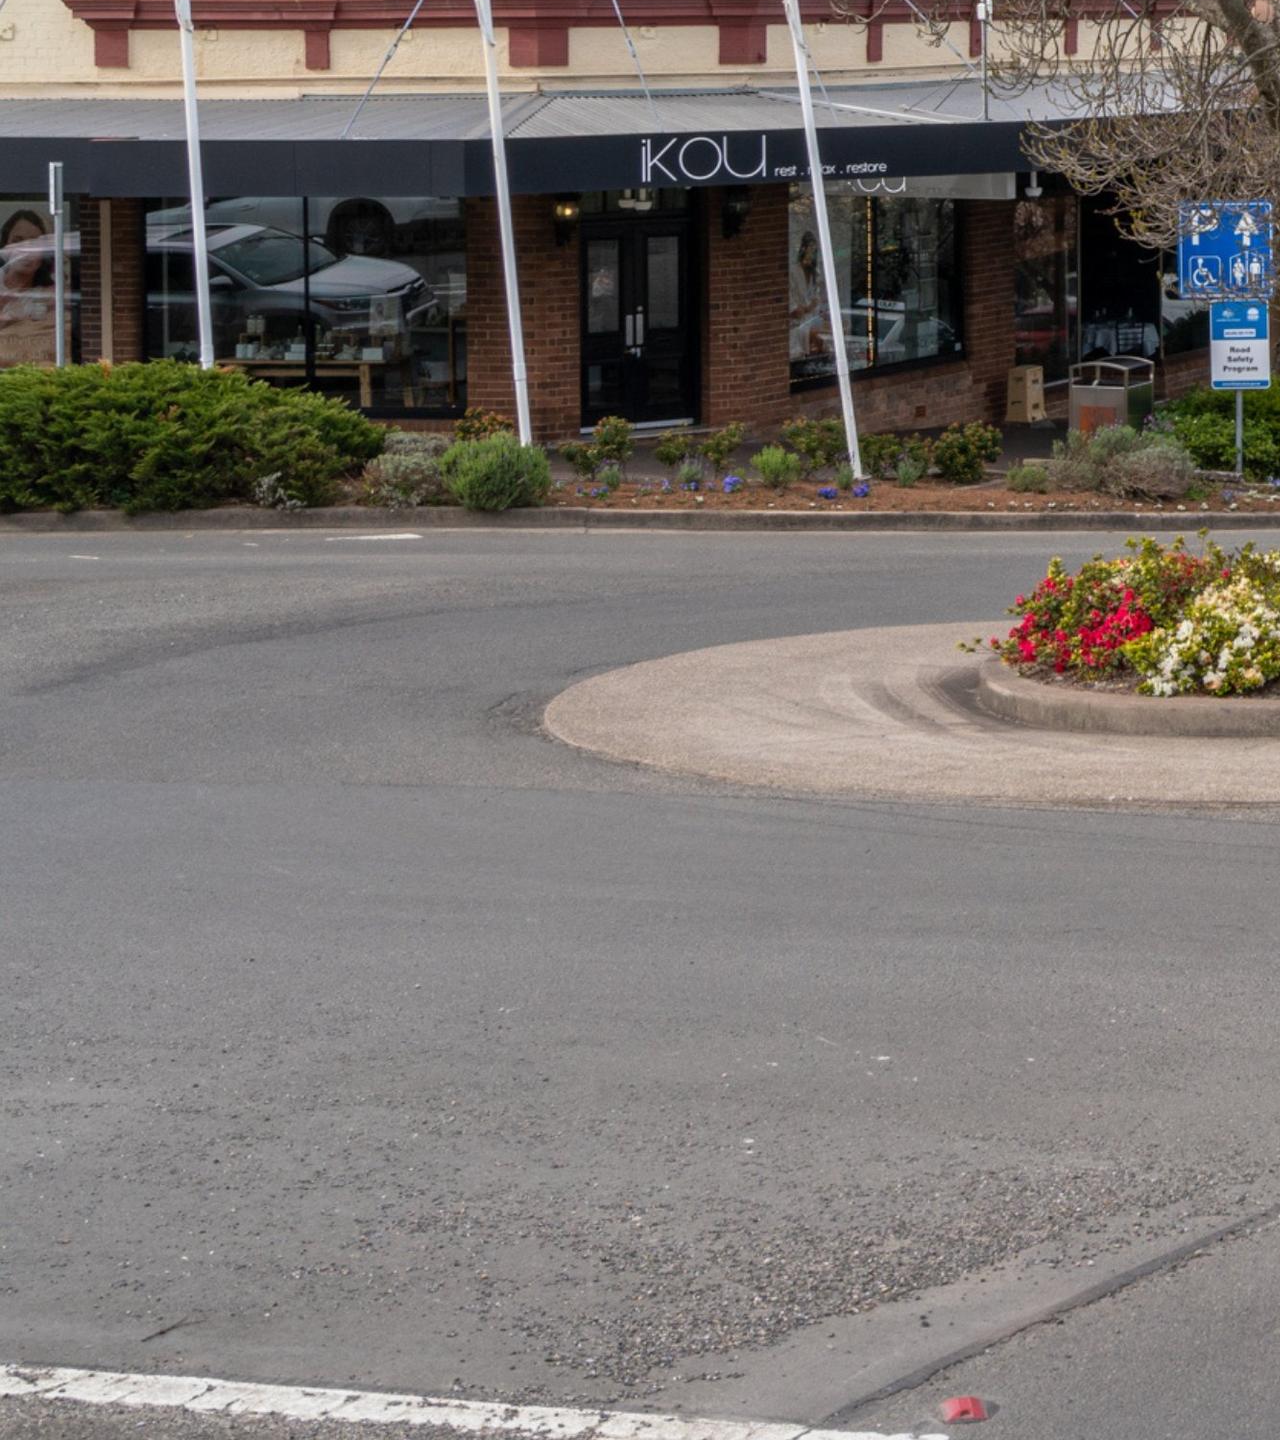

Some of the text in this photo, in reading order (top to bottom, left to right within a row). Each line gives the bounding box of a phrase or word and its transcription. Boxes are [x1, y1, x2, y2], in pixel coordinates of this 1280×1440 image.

[774, 166, 797, 177] rest
[846, 162, 887, 174] restore
[1227, 356, 1254, 364] Safety
